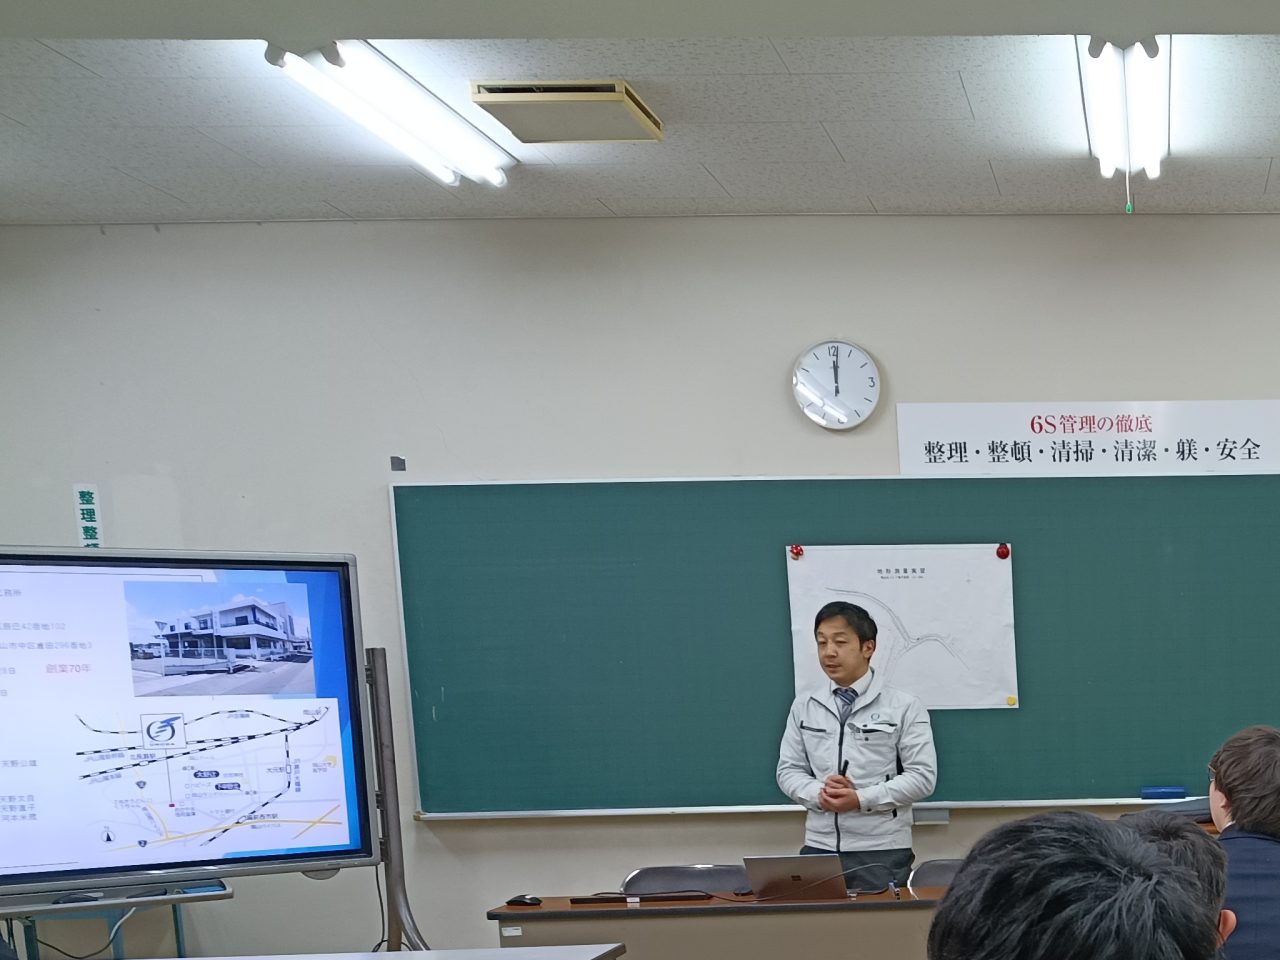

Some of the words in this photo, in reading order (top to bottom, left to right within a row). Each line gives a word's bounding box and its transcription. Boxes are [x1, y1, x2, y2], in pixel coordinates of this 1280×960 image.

[867, 376, 876, 388] 3
[1030, 414, 1153, 434] 6S管理の徹底
